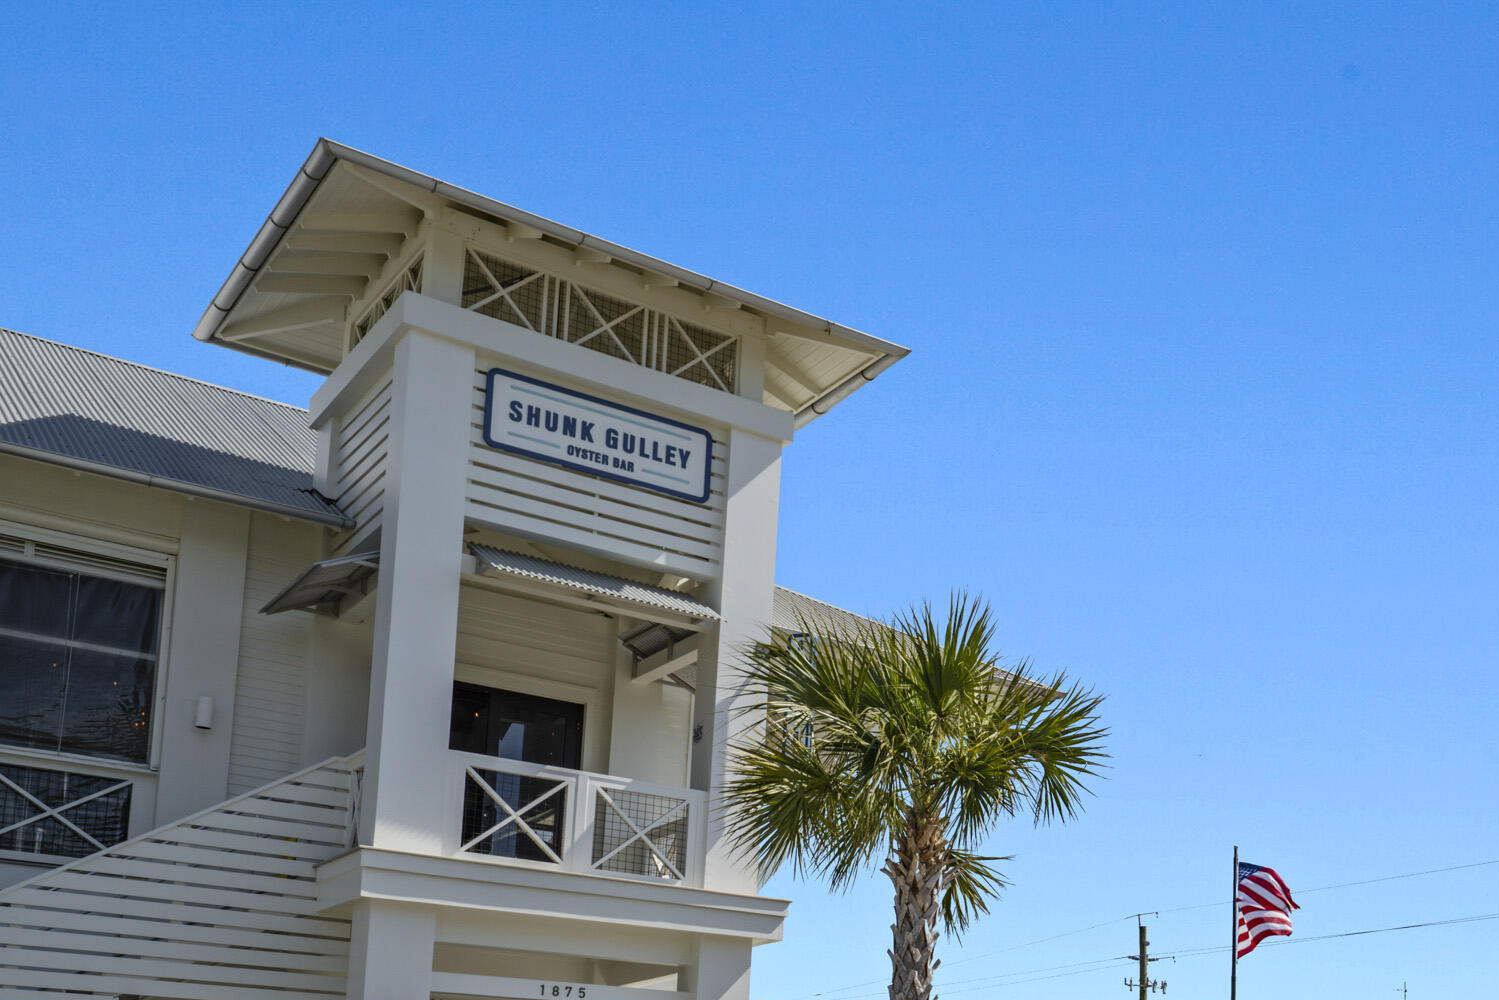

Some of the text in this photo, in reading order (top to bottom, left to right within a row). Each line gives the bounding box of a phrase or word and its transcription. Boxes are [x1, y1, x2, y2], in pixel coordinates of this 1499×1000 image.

[508, 401, 692, 469] SHUNK GULLEY
[567, 445, 635, 473] OYSTER BAR
[540, 984, 586, 999] 1875
